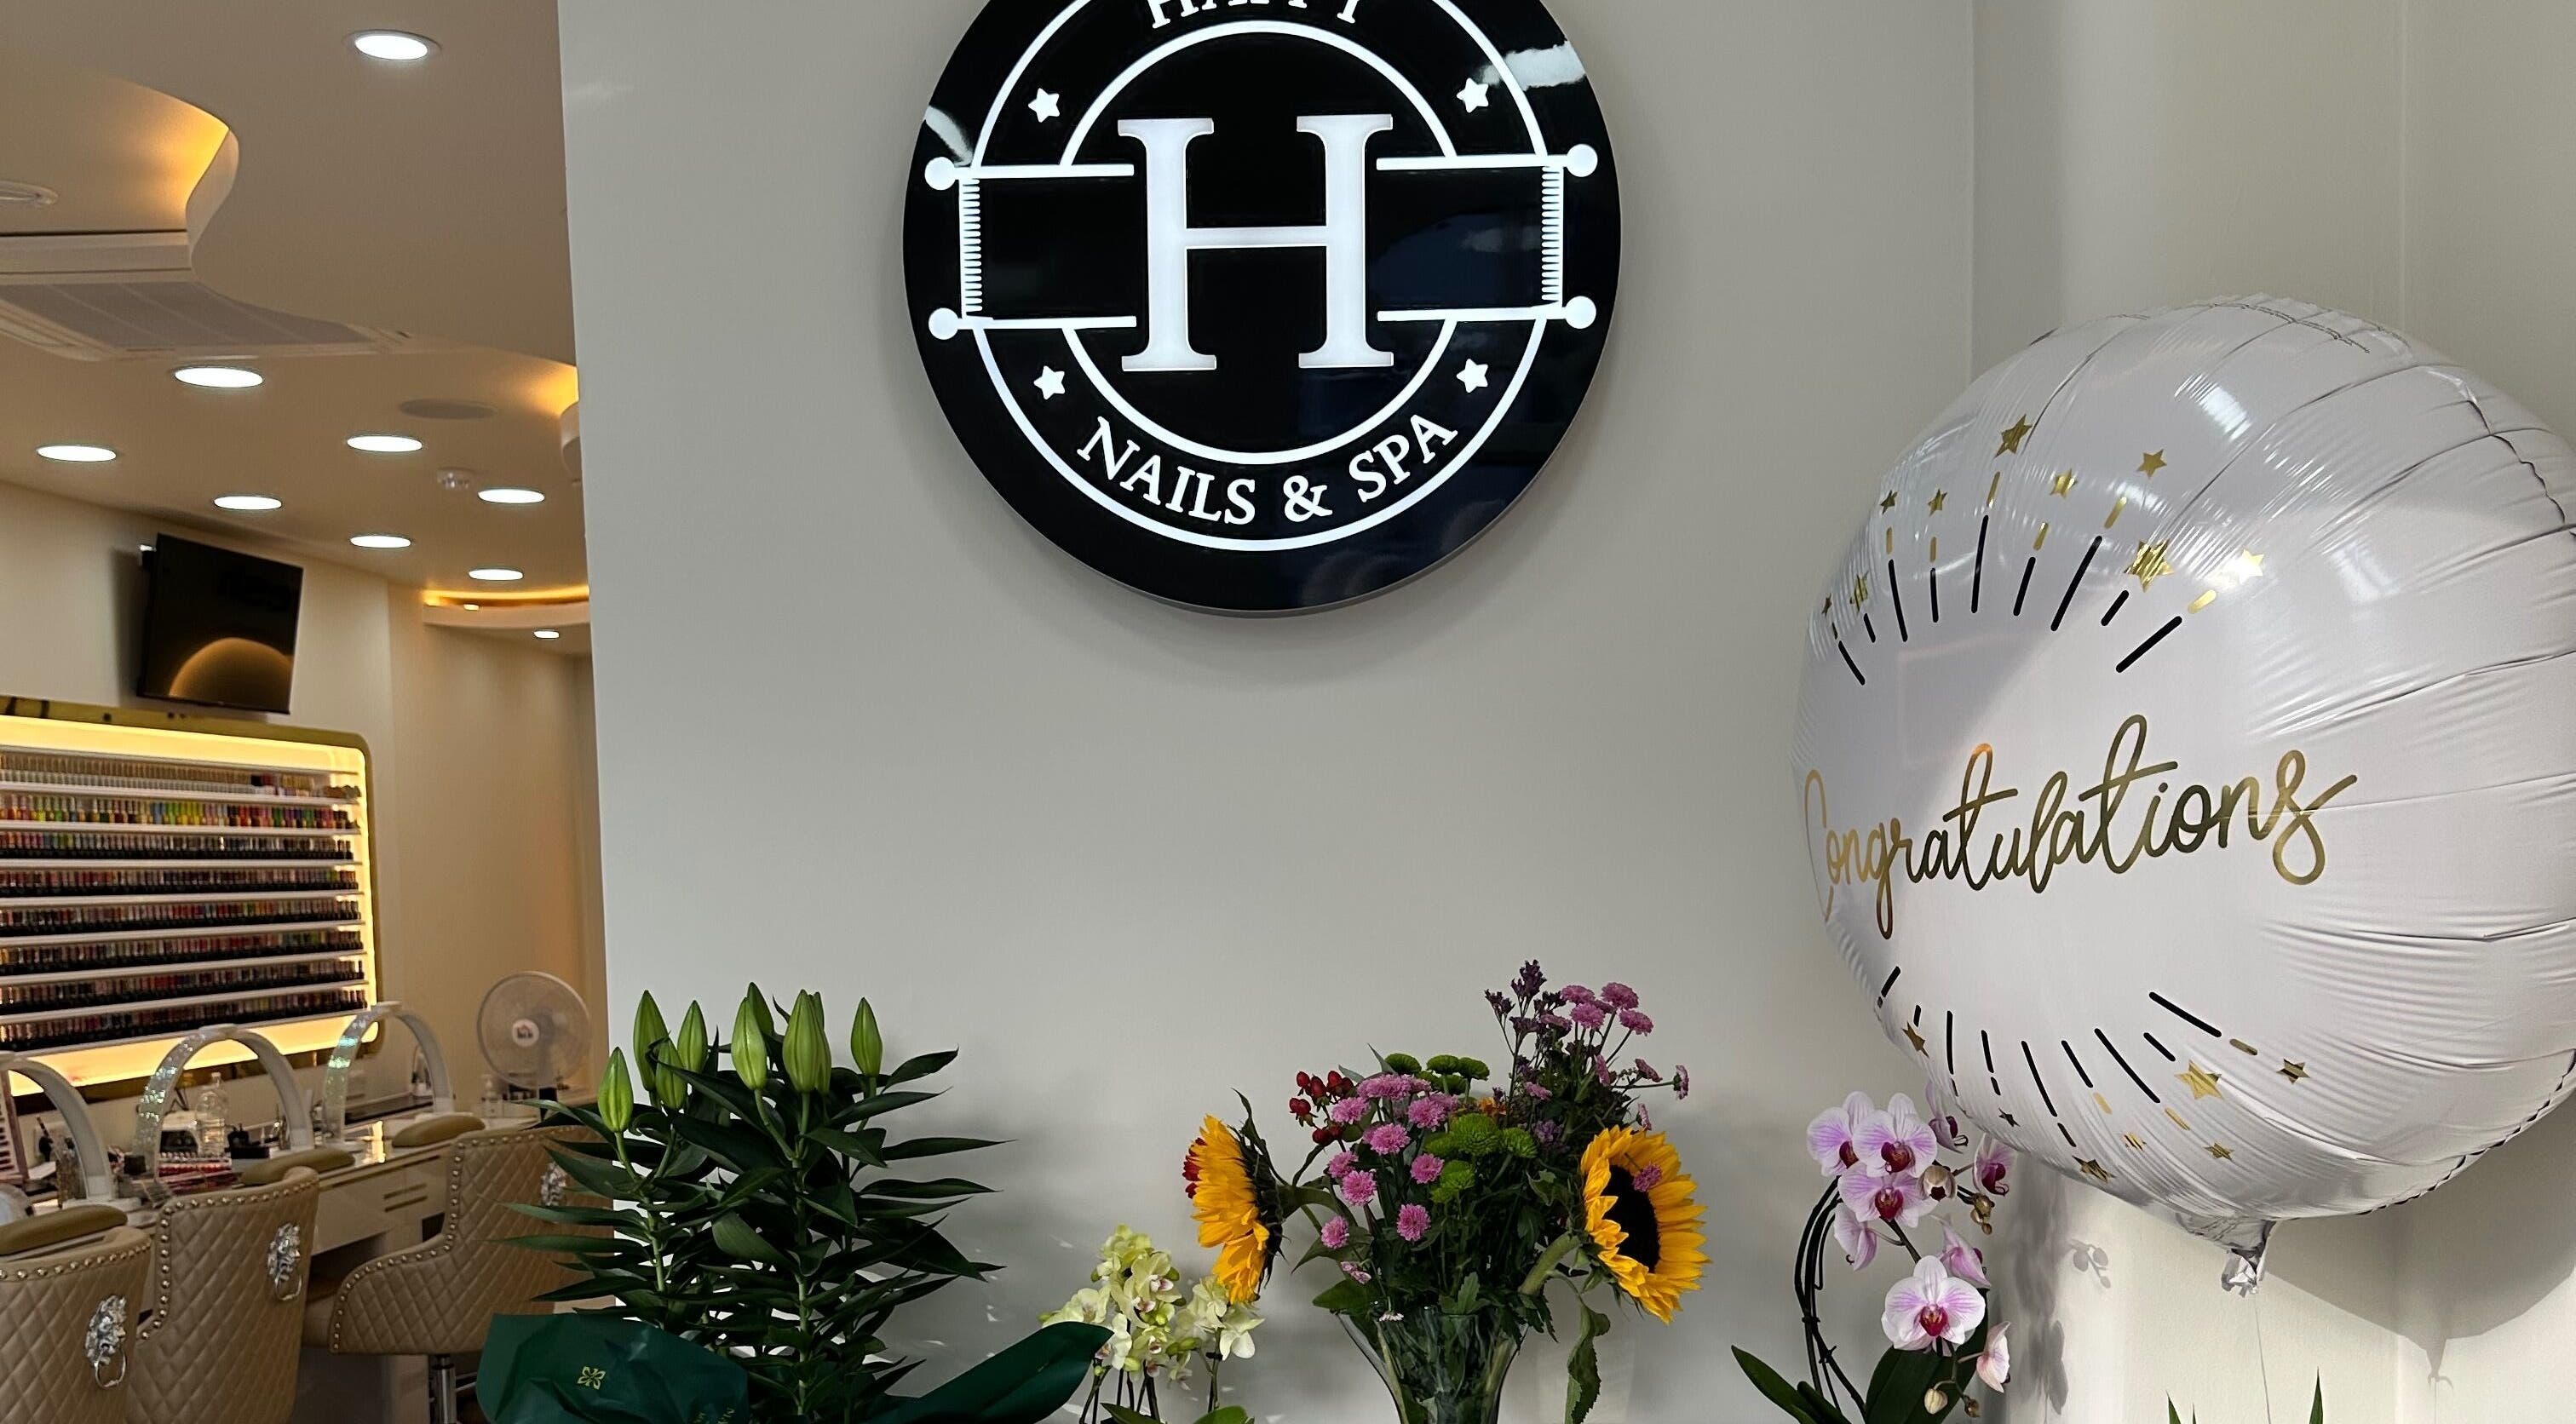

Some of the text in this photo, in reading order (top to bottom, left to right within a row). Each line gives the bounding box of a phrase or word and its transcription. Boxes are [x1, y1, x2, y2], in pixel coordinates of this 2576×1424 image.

[1118, 114, 1394, 372] H
[1076, 414, 1458, 525] NAILS & SPA
[1803, 714, 2358, 940] Congratulations
